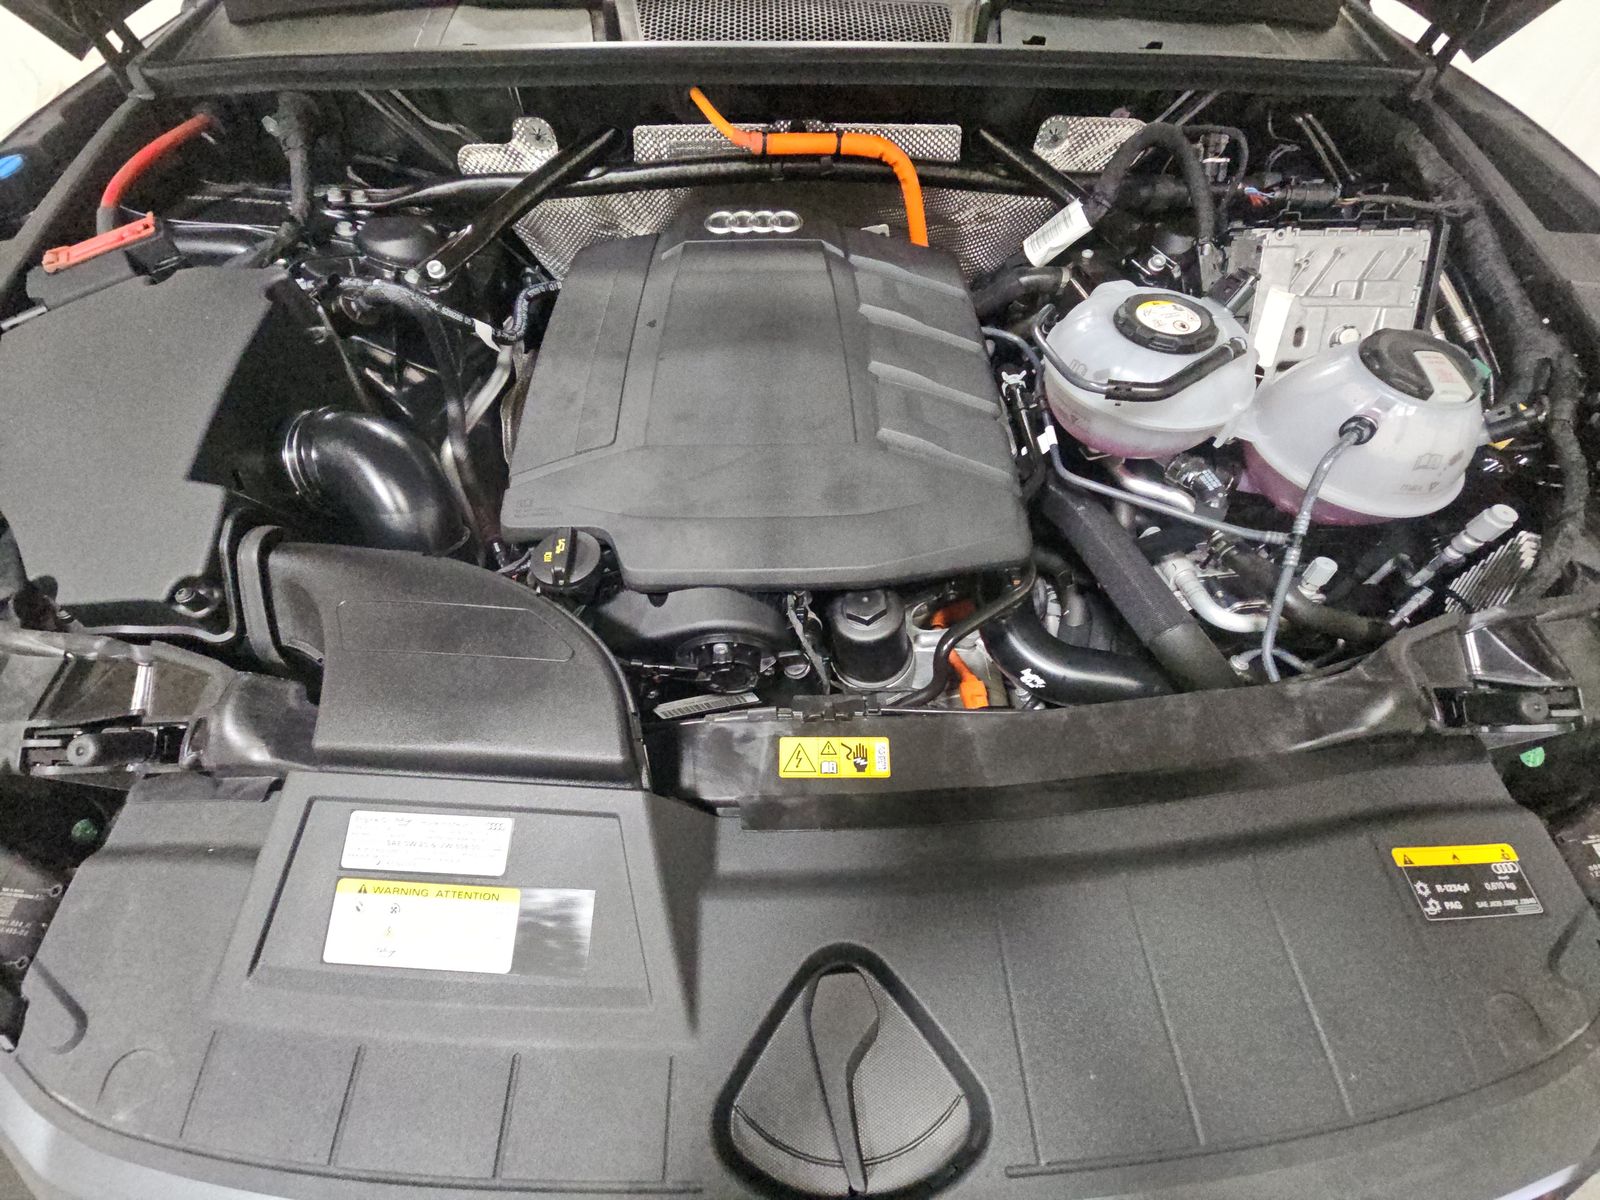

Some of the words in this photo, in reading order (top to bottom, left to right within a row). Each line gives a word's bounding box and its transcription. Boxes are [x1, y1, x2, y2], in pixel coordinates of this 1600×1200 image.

[373, 886, 429, 898] WARNING
[435, 890, 500, 902] ATTENTION
[1443, 900, 1463, 910] PAG
